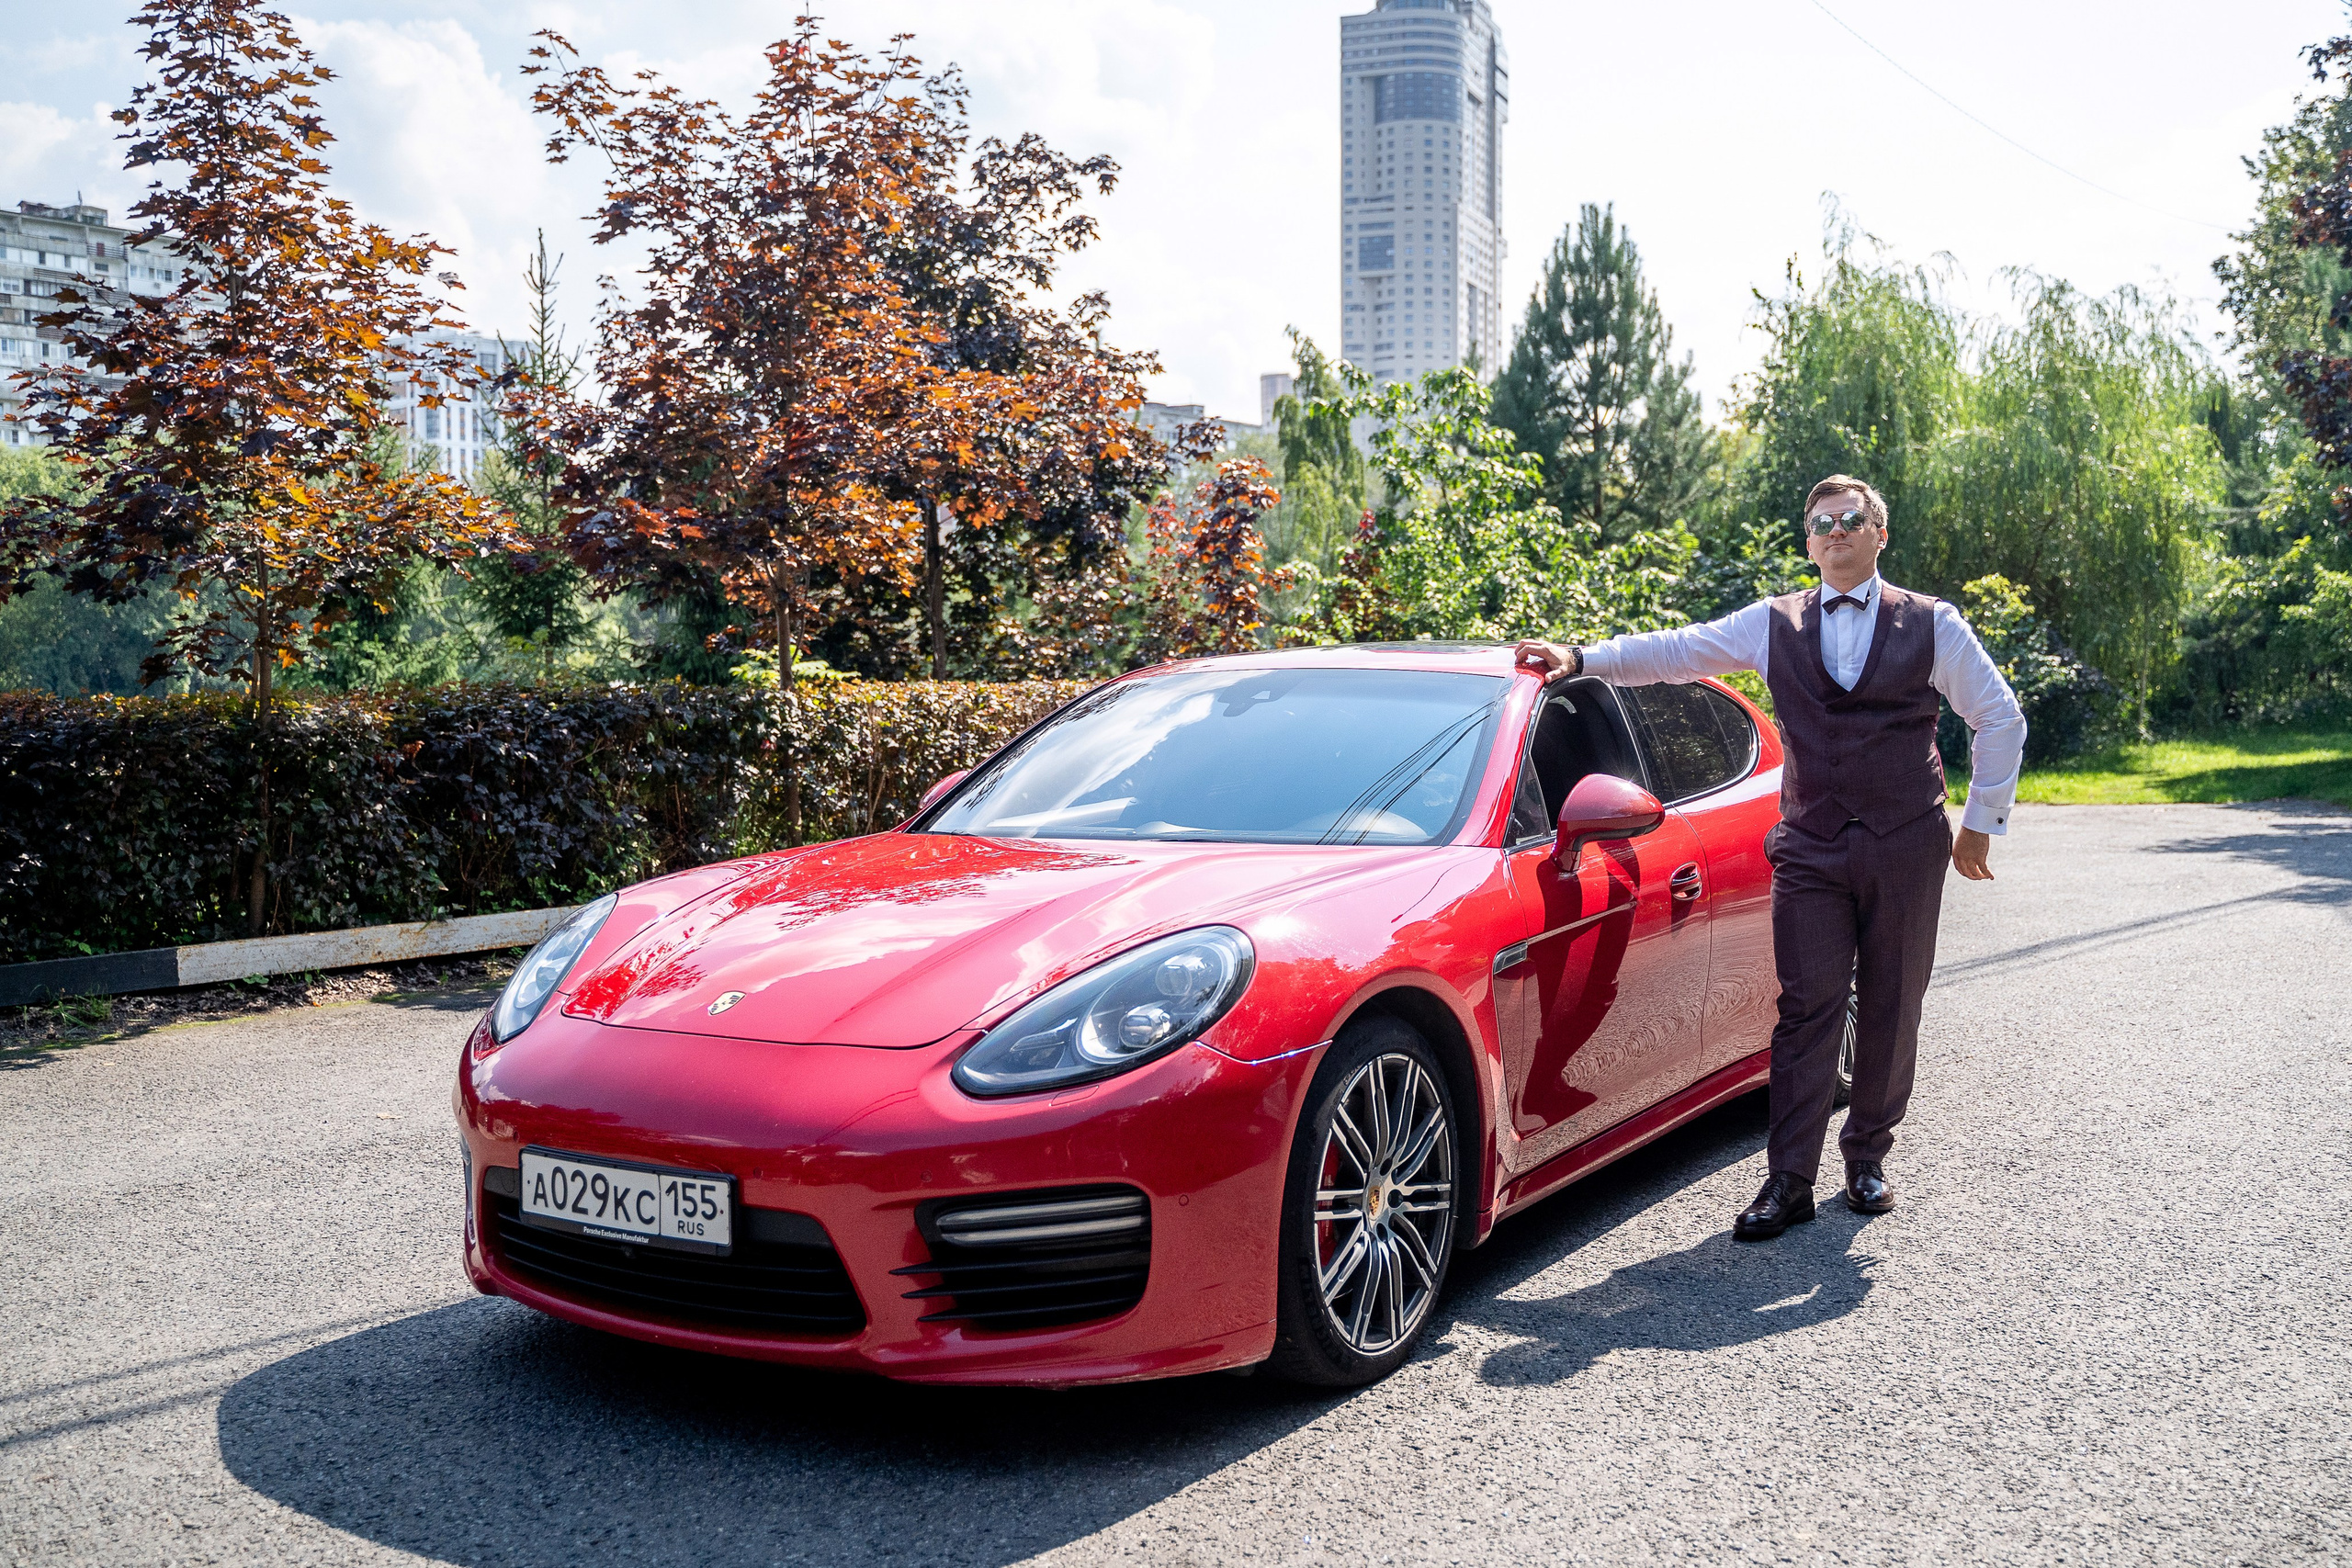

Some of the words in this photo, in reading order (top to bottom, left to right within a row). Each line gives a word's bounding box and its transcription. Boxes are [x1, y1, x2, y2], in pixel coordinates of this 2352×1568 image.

[664, 1180, 718, 1221] 155
[583, 1226, 601, 1235] Porsche
[601, 1229, 622, 1239] Exclusive
[622, 1233, 650, 1244] Manufaktur
[678, 1220, 705, 1236] RUS
